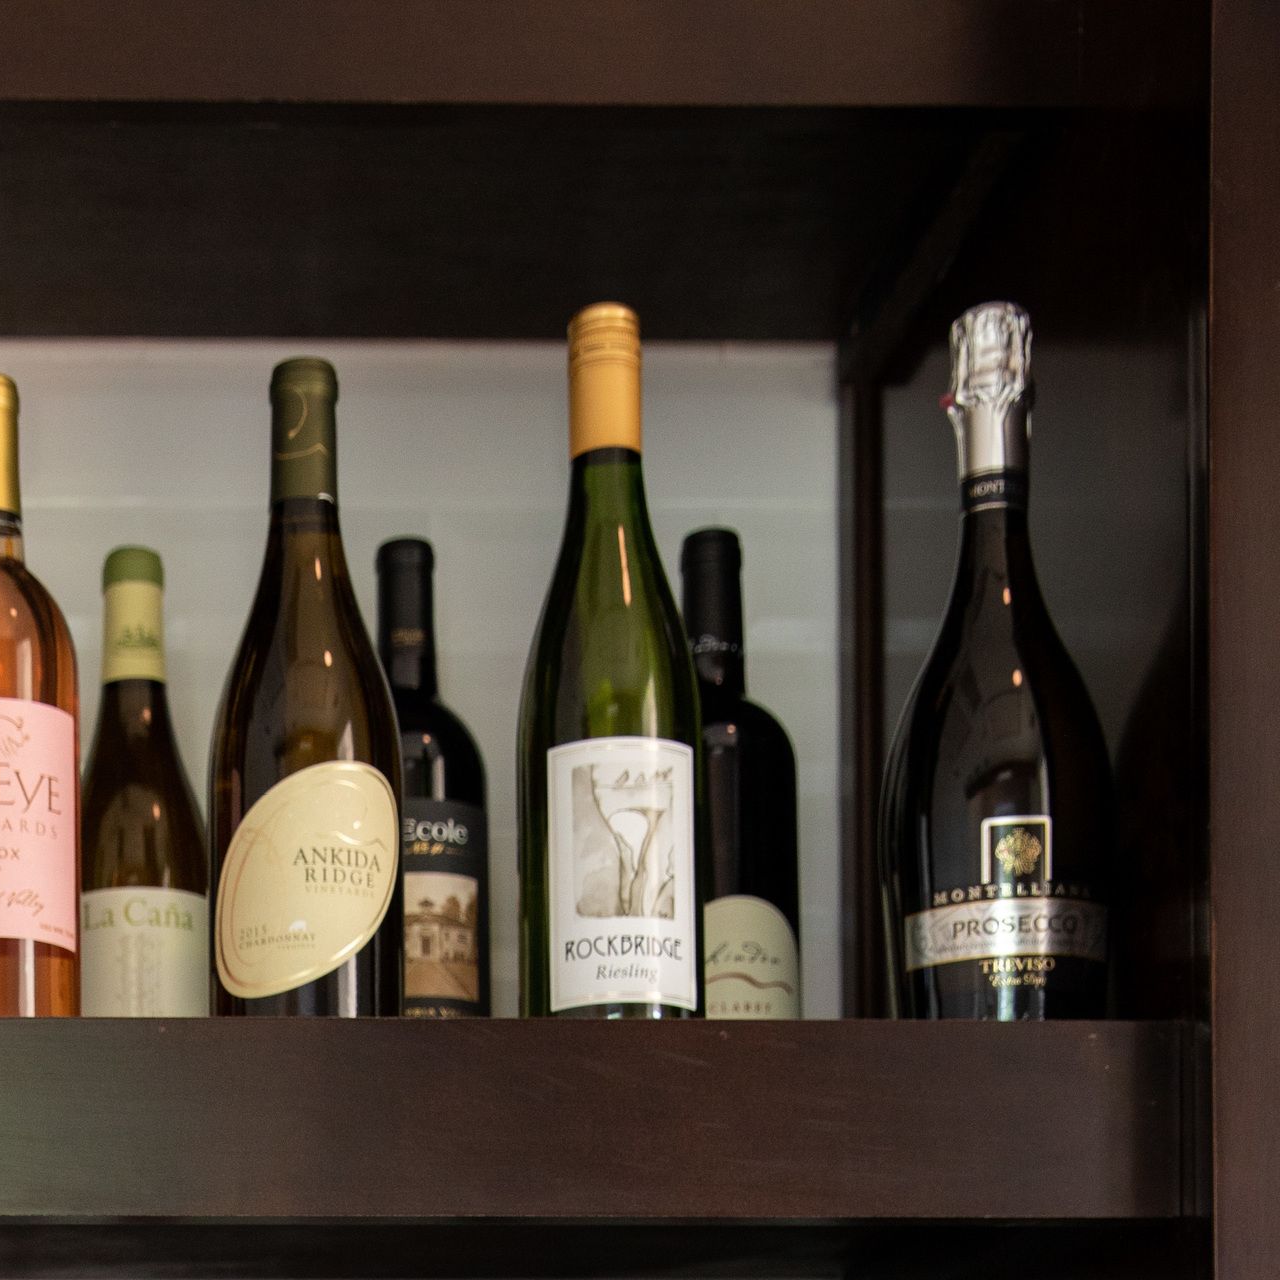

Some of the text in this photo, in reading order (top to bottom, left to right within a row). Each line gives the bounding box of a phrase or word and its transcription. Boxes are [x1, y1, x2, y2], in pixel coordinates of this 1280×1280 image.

[292, 845, 383, 874] ANKIDA
[303, 865, 376, 889] RIDGE
[81, 902, 116, 931] La
[122, 897, 194, 932] Caña
[951, 912, 1079, 940] PROSECCO
[237, 931, 317, 951] CHARDONNAY
[564, 935, 684, 962] ROCKBRIDGE
[595, 964, 660, 982] Riesling
[979, 956, 1057, 975] TREVISO
